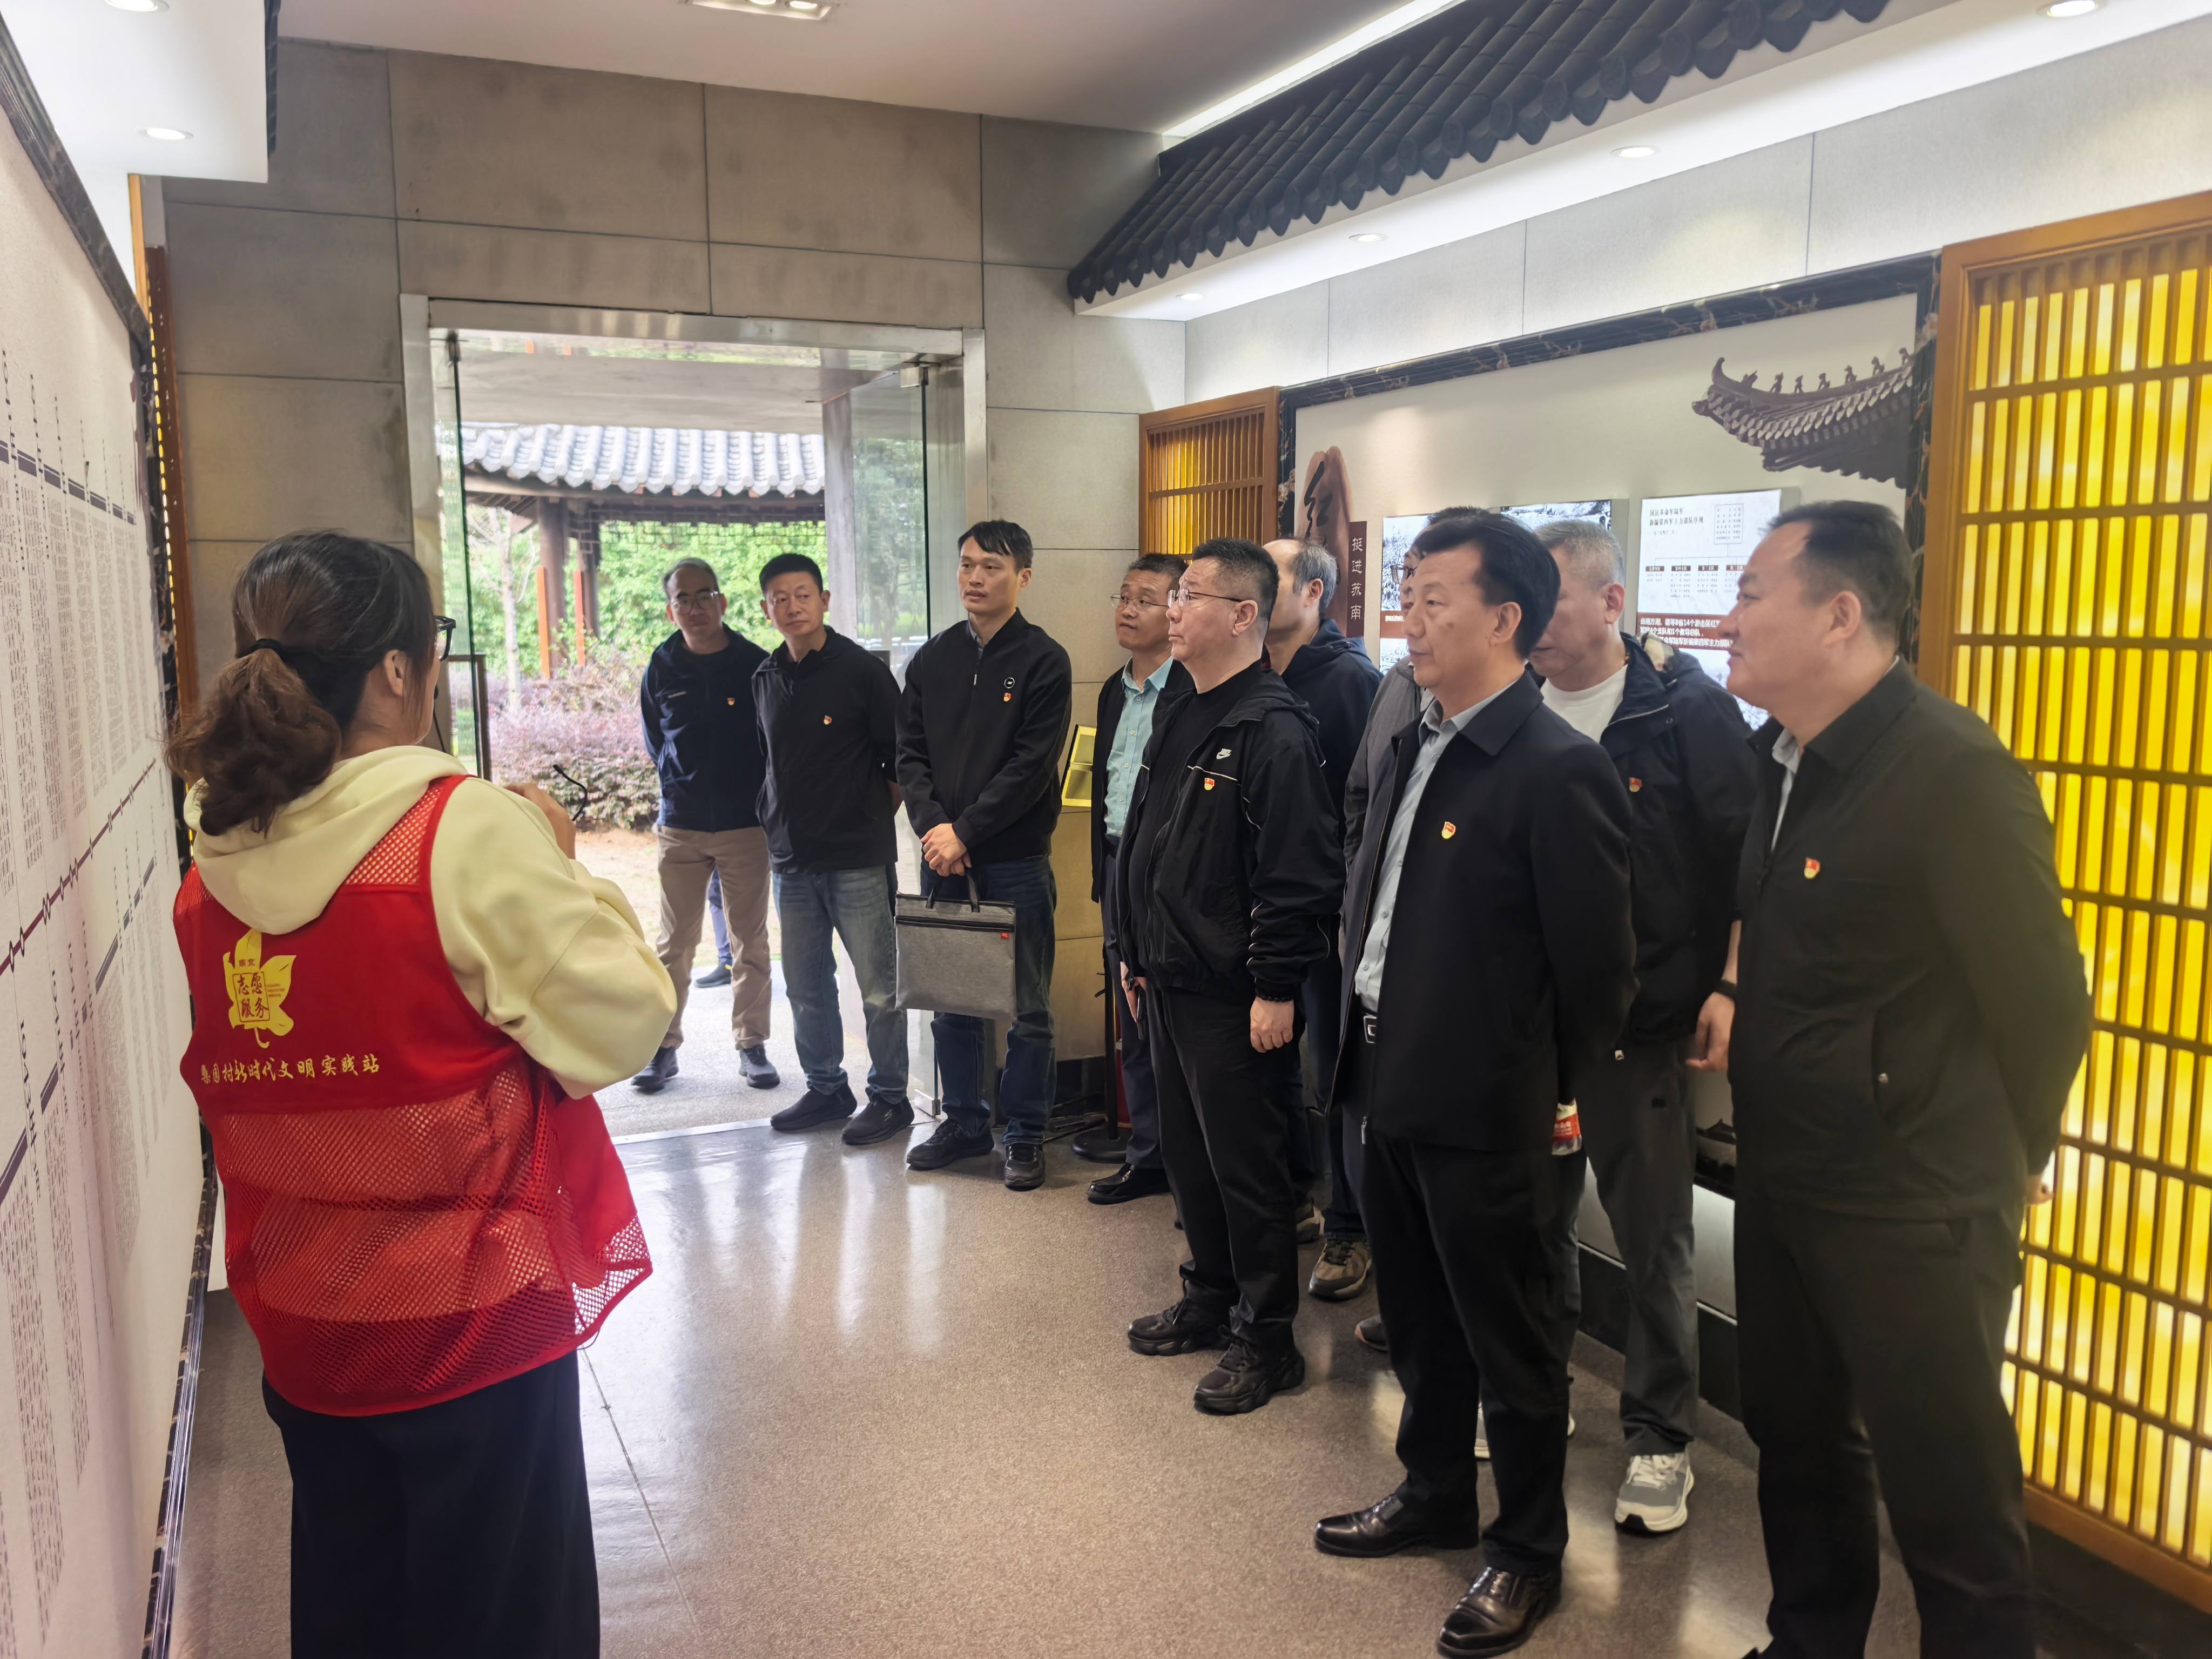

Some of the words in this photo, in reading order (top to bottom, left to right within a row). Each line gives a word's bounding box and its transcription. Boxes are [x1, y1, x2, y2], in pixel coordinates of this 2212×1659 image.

[1350, 537, 1363, 621] 挺进苏南
[237, 972, 262, 995] 志愿
[241, 997, 269, 1018] 服务
